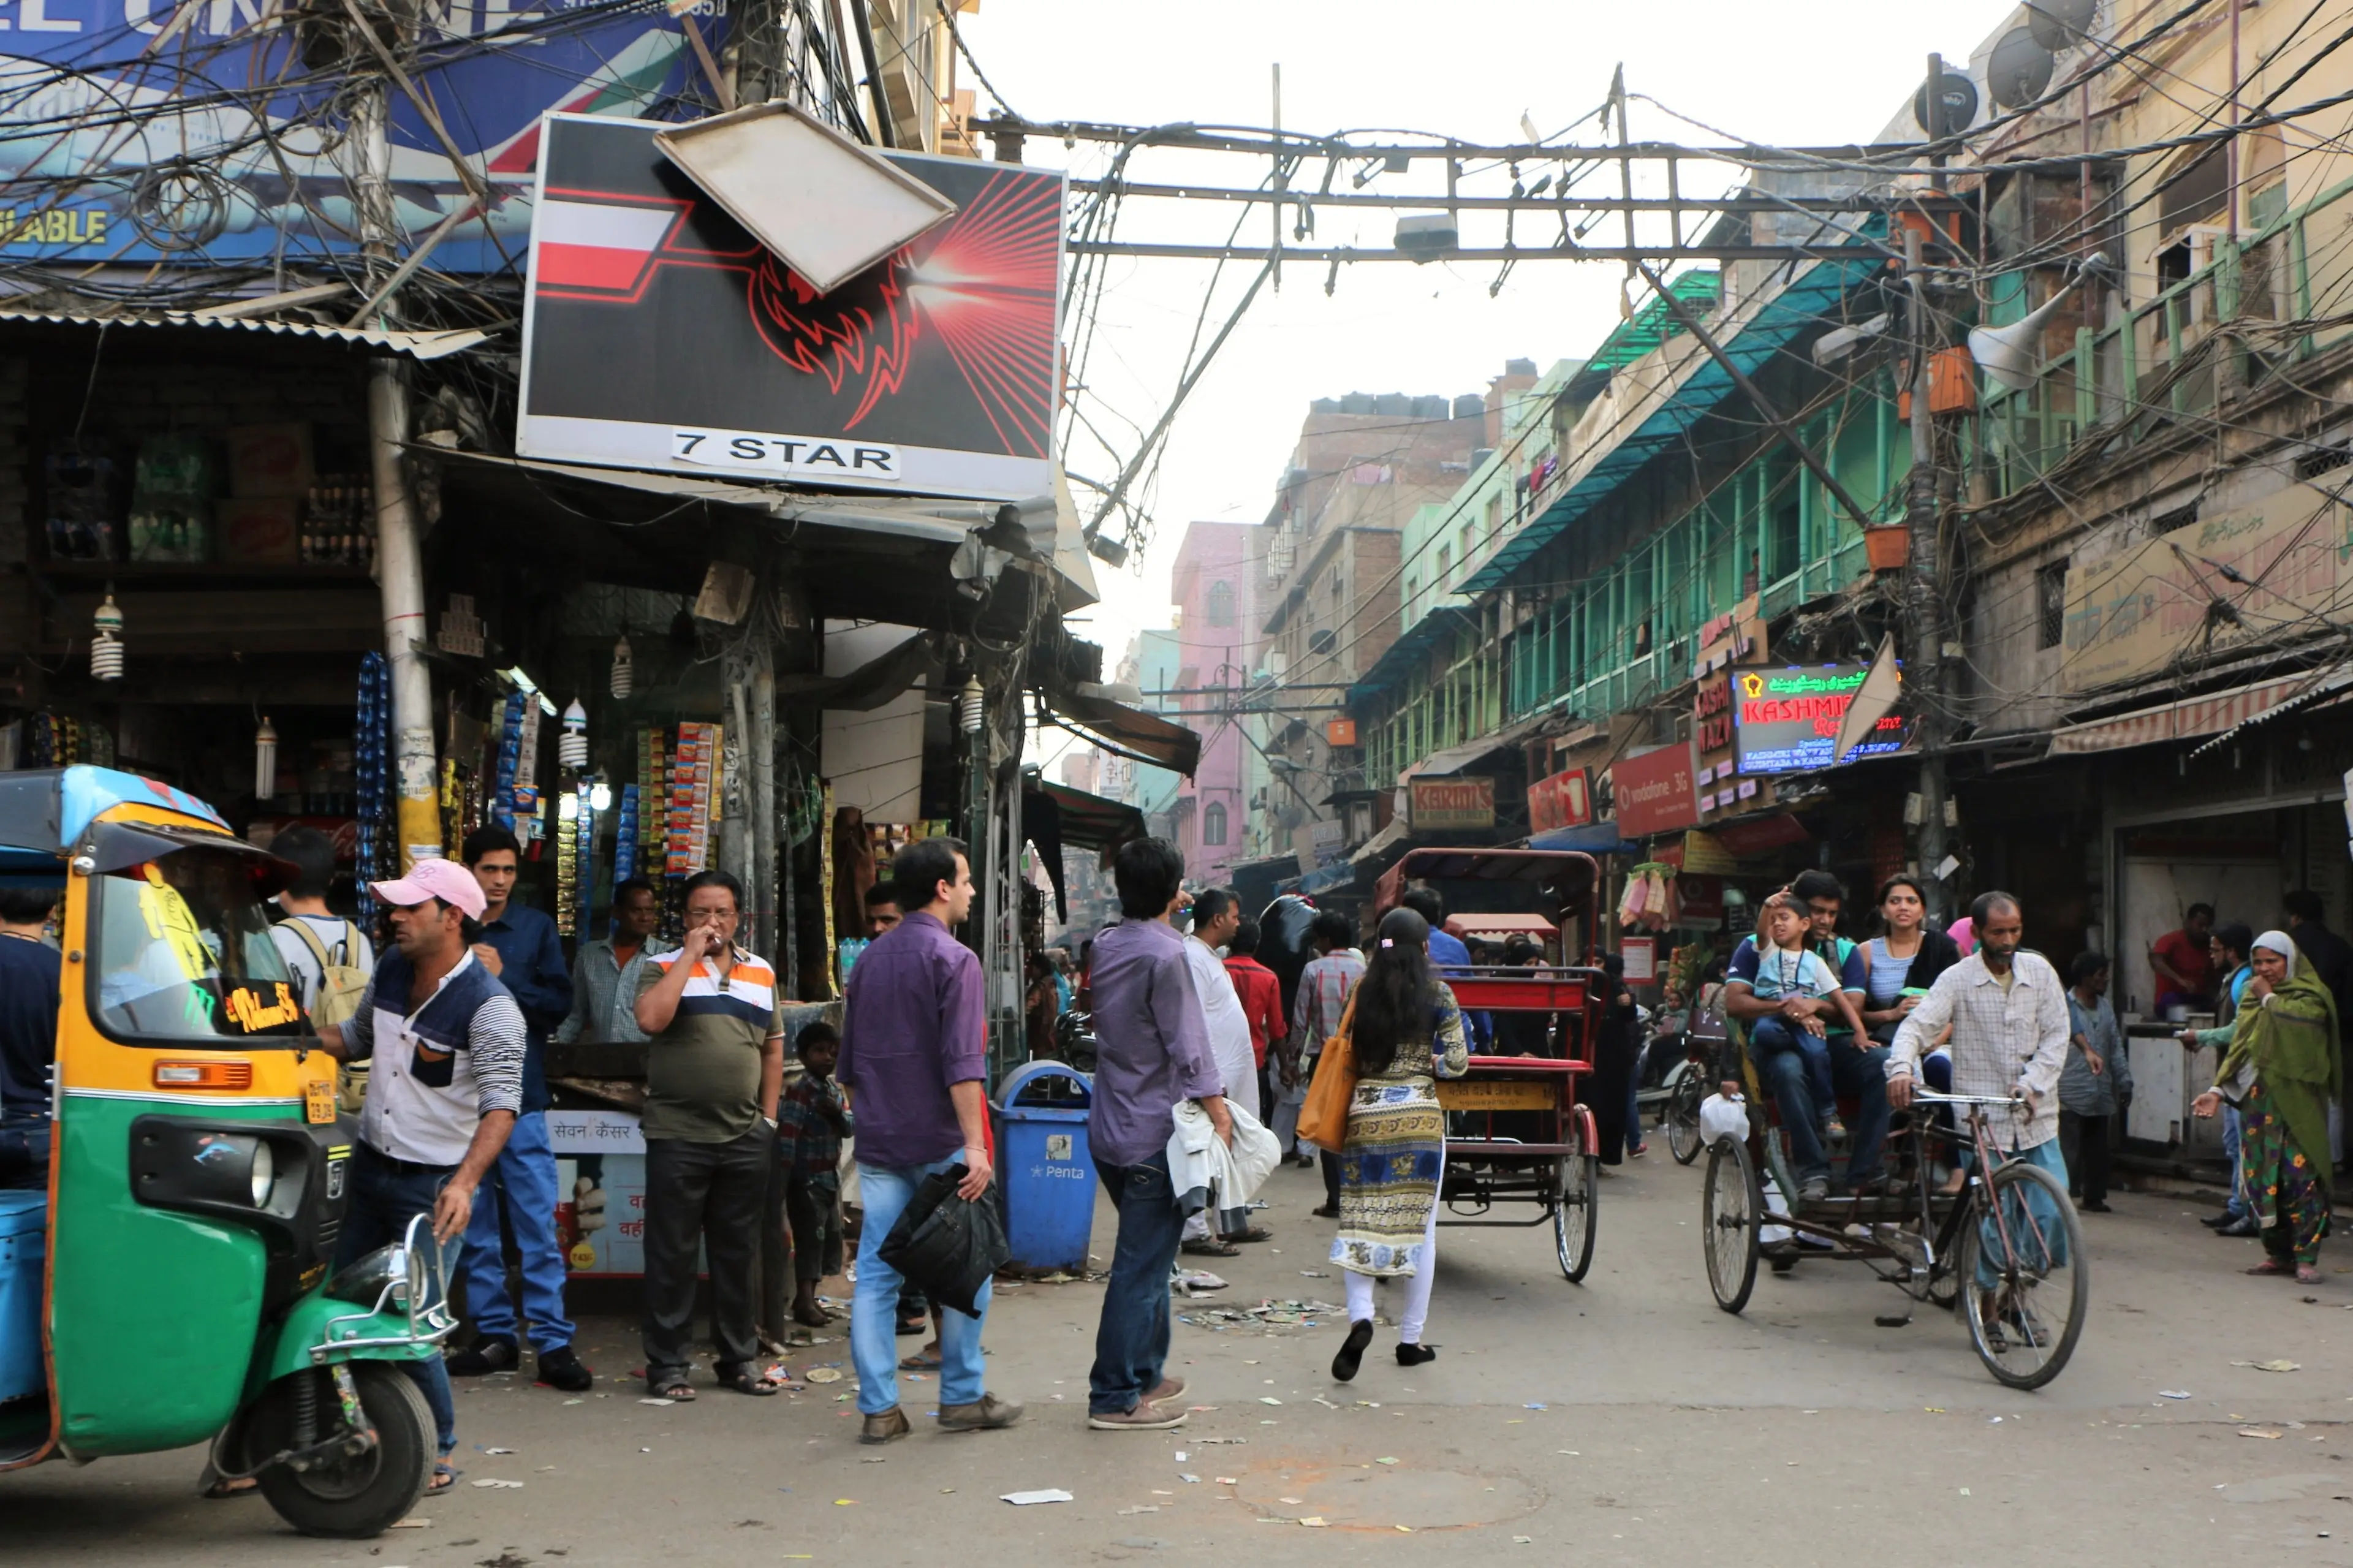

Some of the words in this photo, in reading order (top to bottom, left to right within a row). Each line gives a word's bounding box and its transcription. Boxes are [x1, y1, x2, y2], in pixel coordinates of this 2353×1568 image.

[676, 434, 706, 454] 7
[729, 438, 892, 471] STAR
[1631, 780, 1670, 804] vodafone
[1674, 771, 1688, 792] 3G
[1046, 1165, 1085, 1179] Penta
